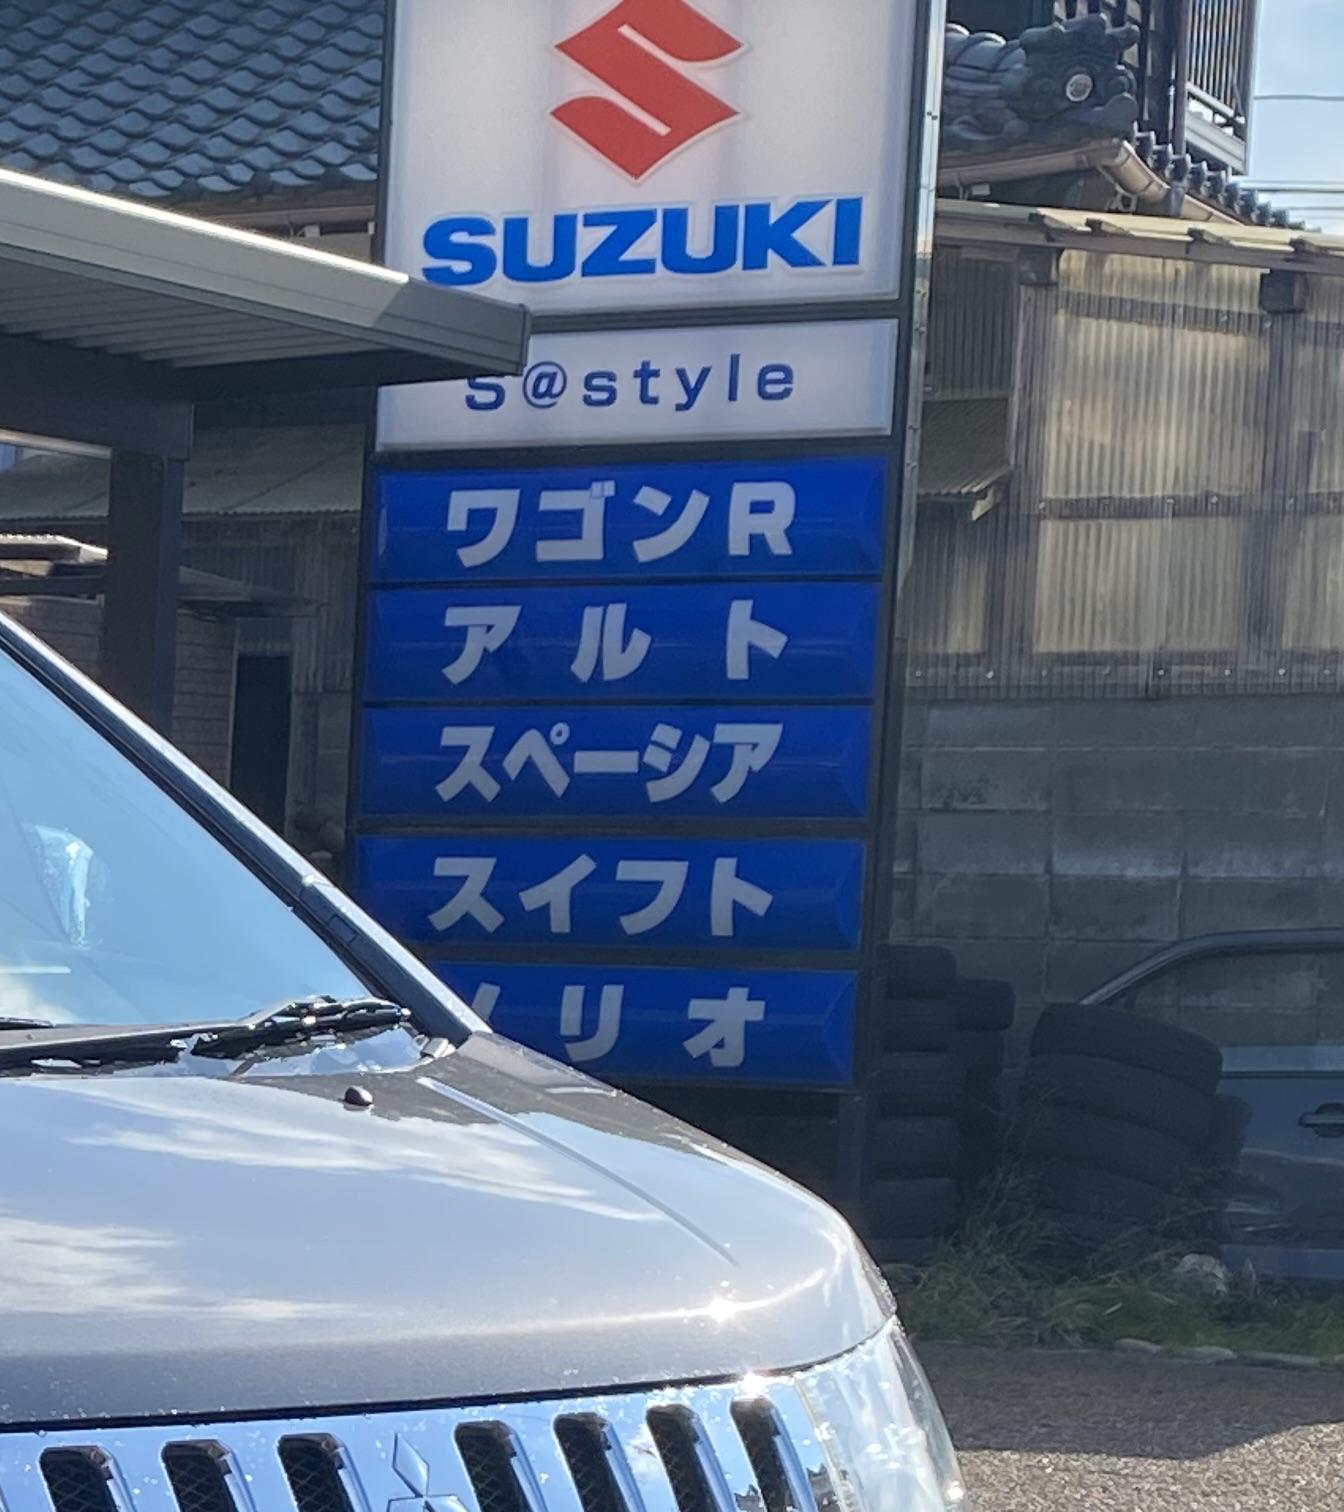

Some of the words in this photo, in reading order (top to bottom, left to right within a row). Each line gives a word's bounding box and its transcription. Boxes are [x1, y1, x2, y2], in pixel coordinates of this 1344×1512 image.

[421, 196, 863, 286] SUZUKI
[446, 480, 797, 568] ワゴンR
[440, 600, 789, 685] アルト
[435, 721, 783, 804] スペーシア
[427, 853, 774, 936] スイフト
